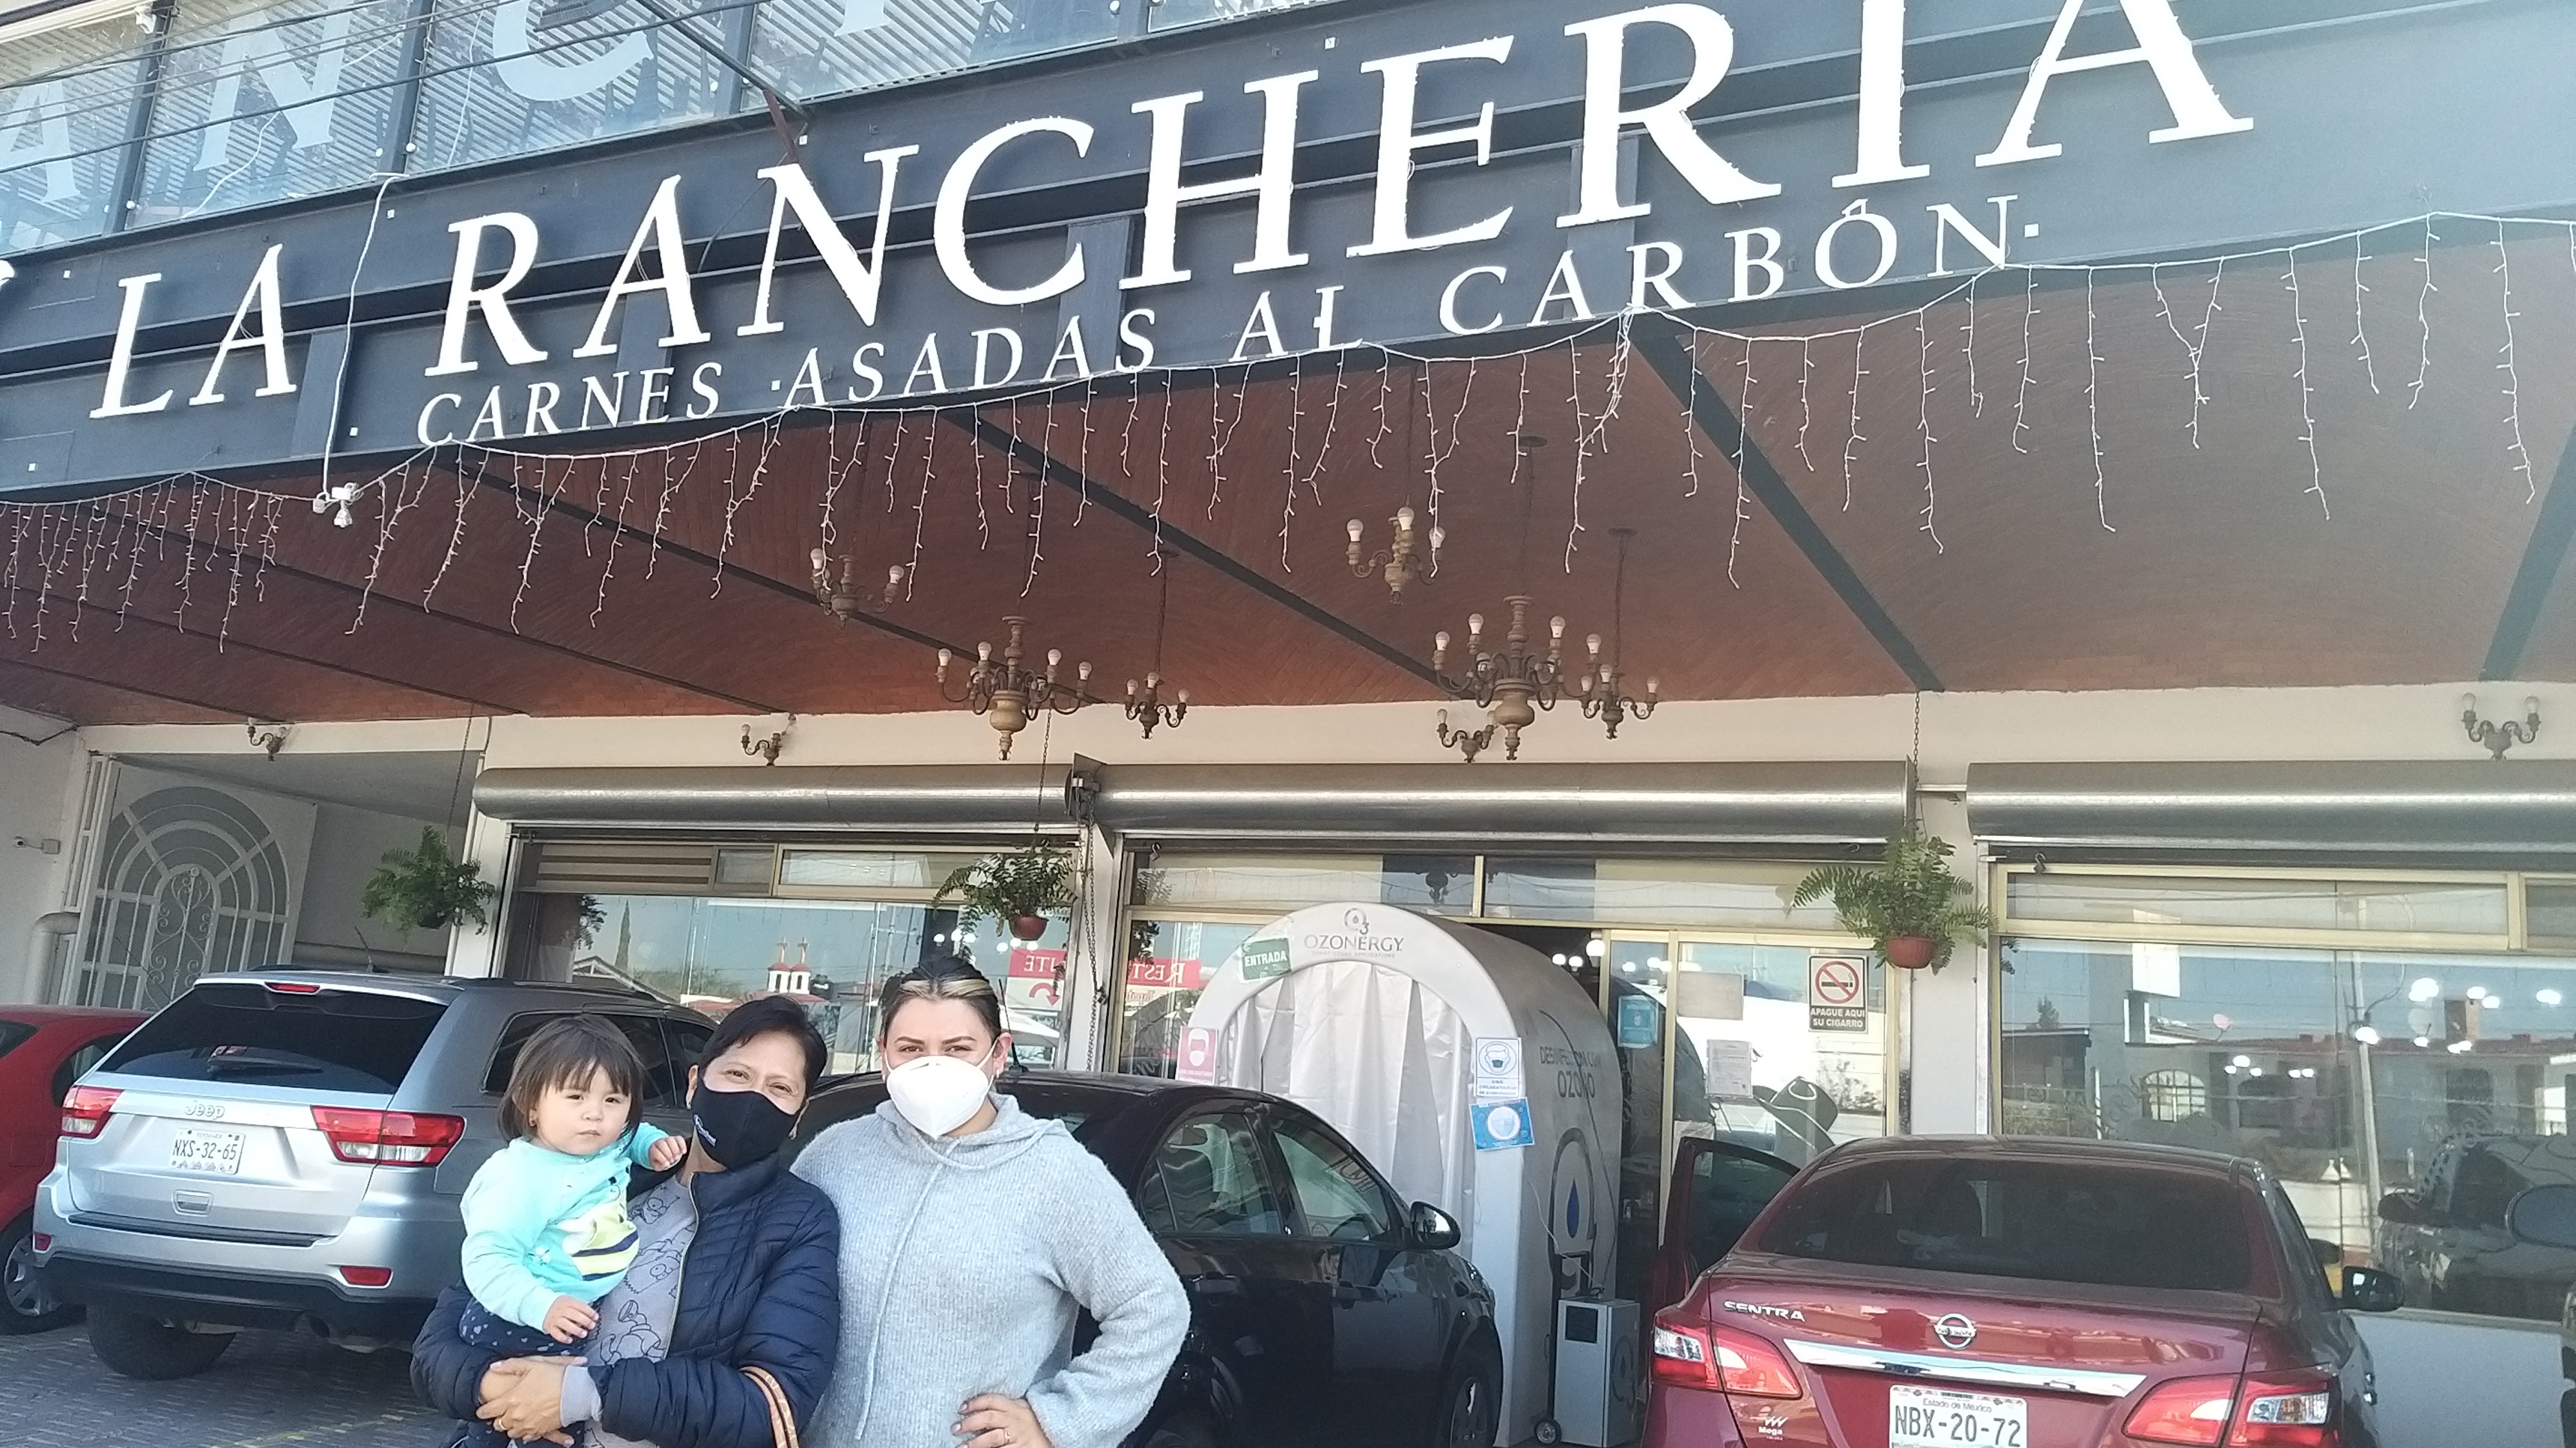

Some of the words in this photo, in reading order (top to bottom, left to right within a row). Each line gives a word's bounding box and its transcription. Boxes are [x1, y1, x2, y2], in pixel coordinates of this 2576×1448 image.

[417, 361, 722, 447] CARNES
[780, 308, 1157, 409] ASADAS
[1230, 284, 1363, 362] AL
[1439, 194, 2019, 336] CARBÓN
[89, 244, 297, 420] LA
[1244, 950, 1287, 967] ENTRADA
[1810, 1007, 1843, 1016] APAGUE
[1845, 1009, 1865, 1018] AQUI
[1812, 1018, 1825, 1026] SU
[1826, 1018, 1863, 1028] CIGARRO
[184, 1100, 225, 1121] Jeep
[172, 1139, 238, 1160] NXS-32-65
[1724, 1300, 1805, 1323] SENTRA
[1923, 1398, 1950, 1408] Estado
[1951, 1401, 1961, 1409] de
[1895, 1405, 2021, 1448] NBX-20-72
